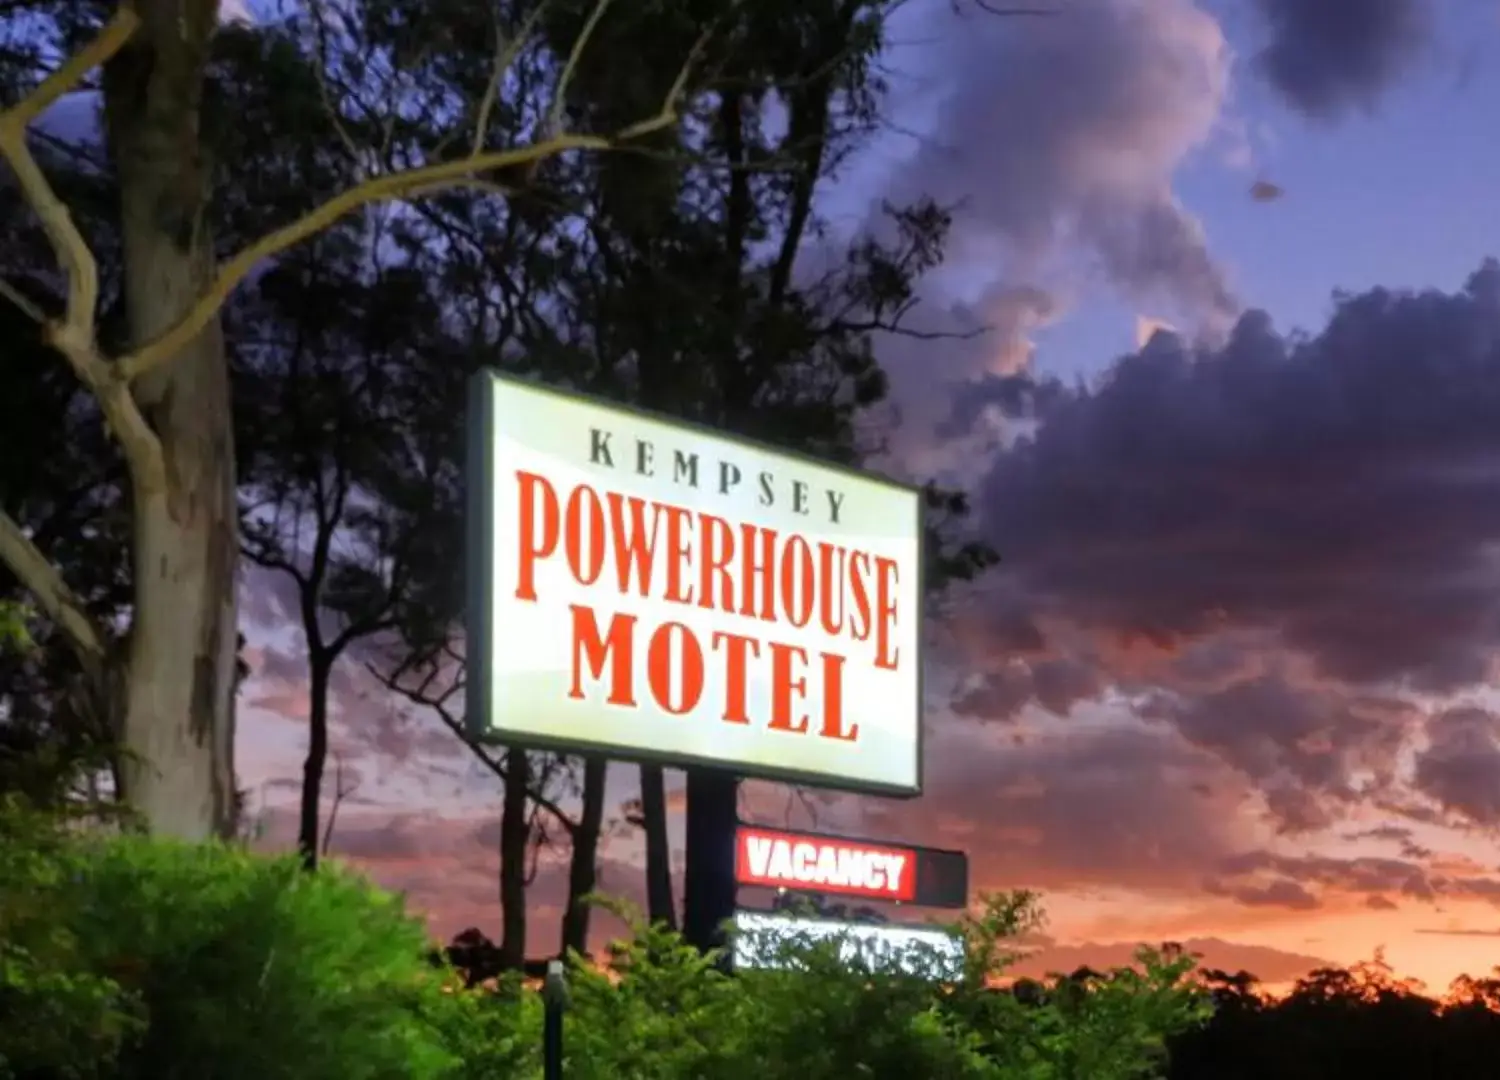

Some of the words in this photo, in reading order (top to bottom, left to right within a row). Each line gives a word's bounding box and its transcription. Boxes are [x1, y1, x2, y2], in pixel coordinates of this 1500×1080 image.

[589, 428, 846, 524] KEMPSEY
[515, 470, 899, 671] POWERHOUSE
[568, 603, 860, 742] MOTEL
[746, 836, 905, 891] VACANCY
